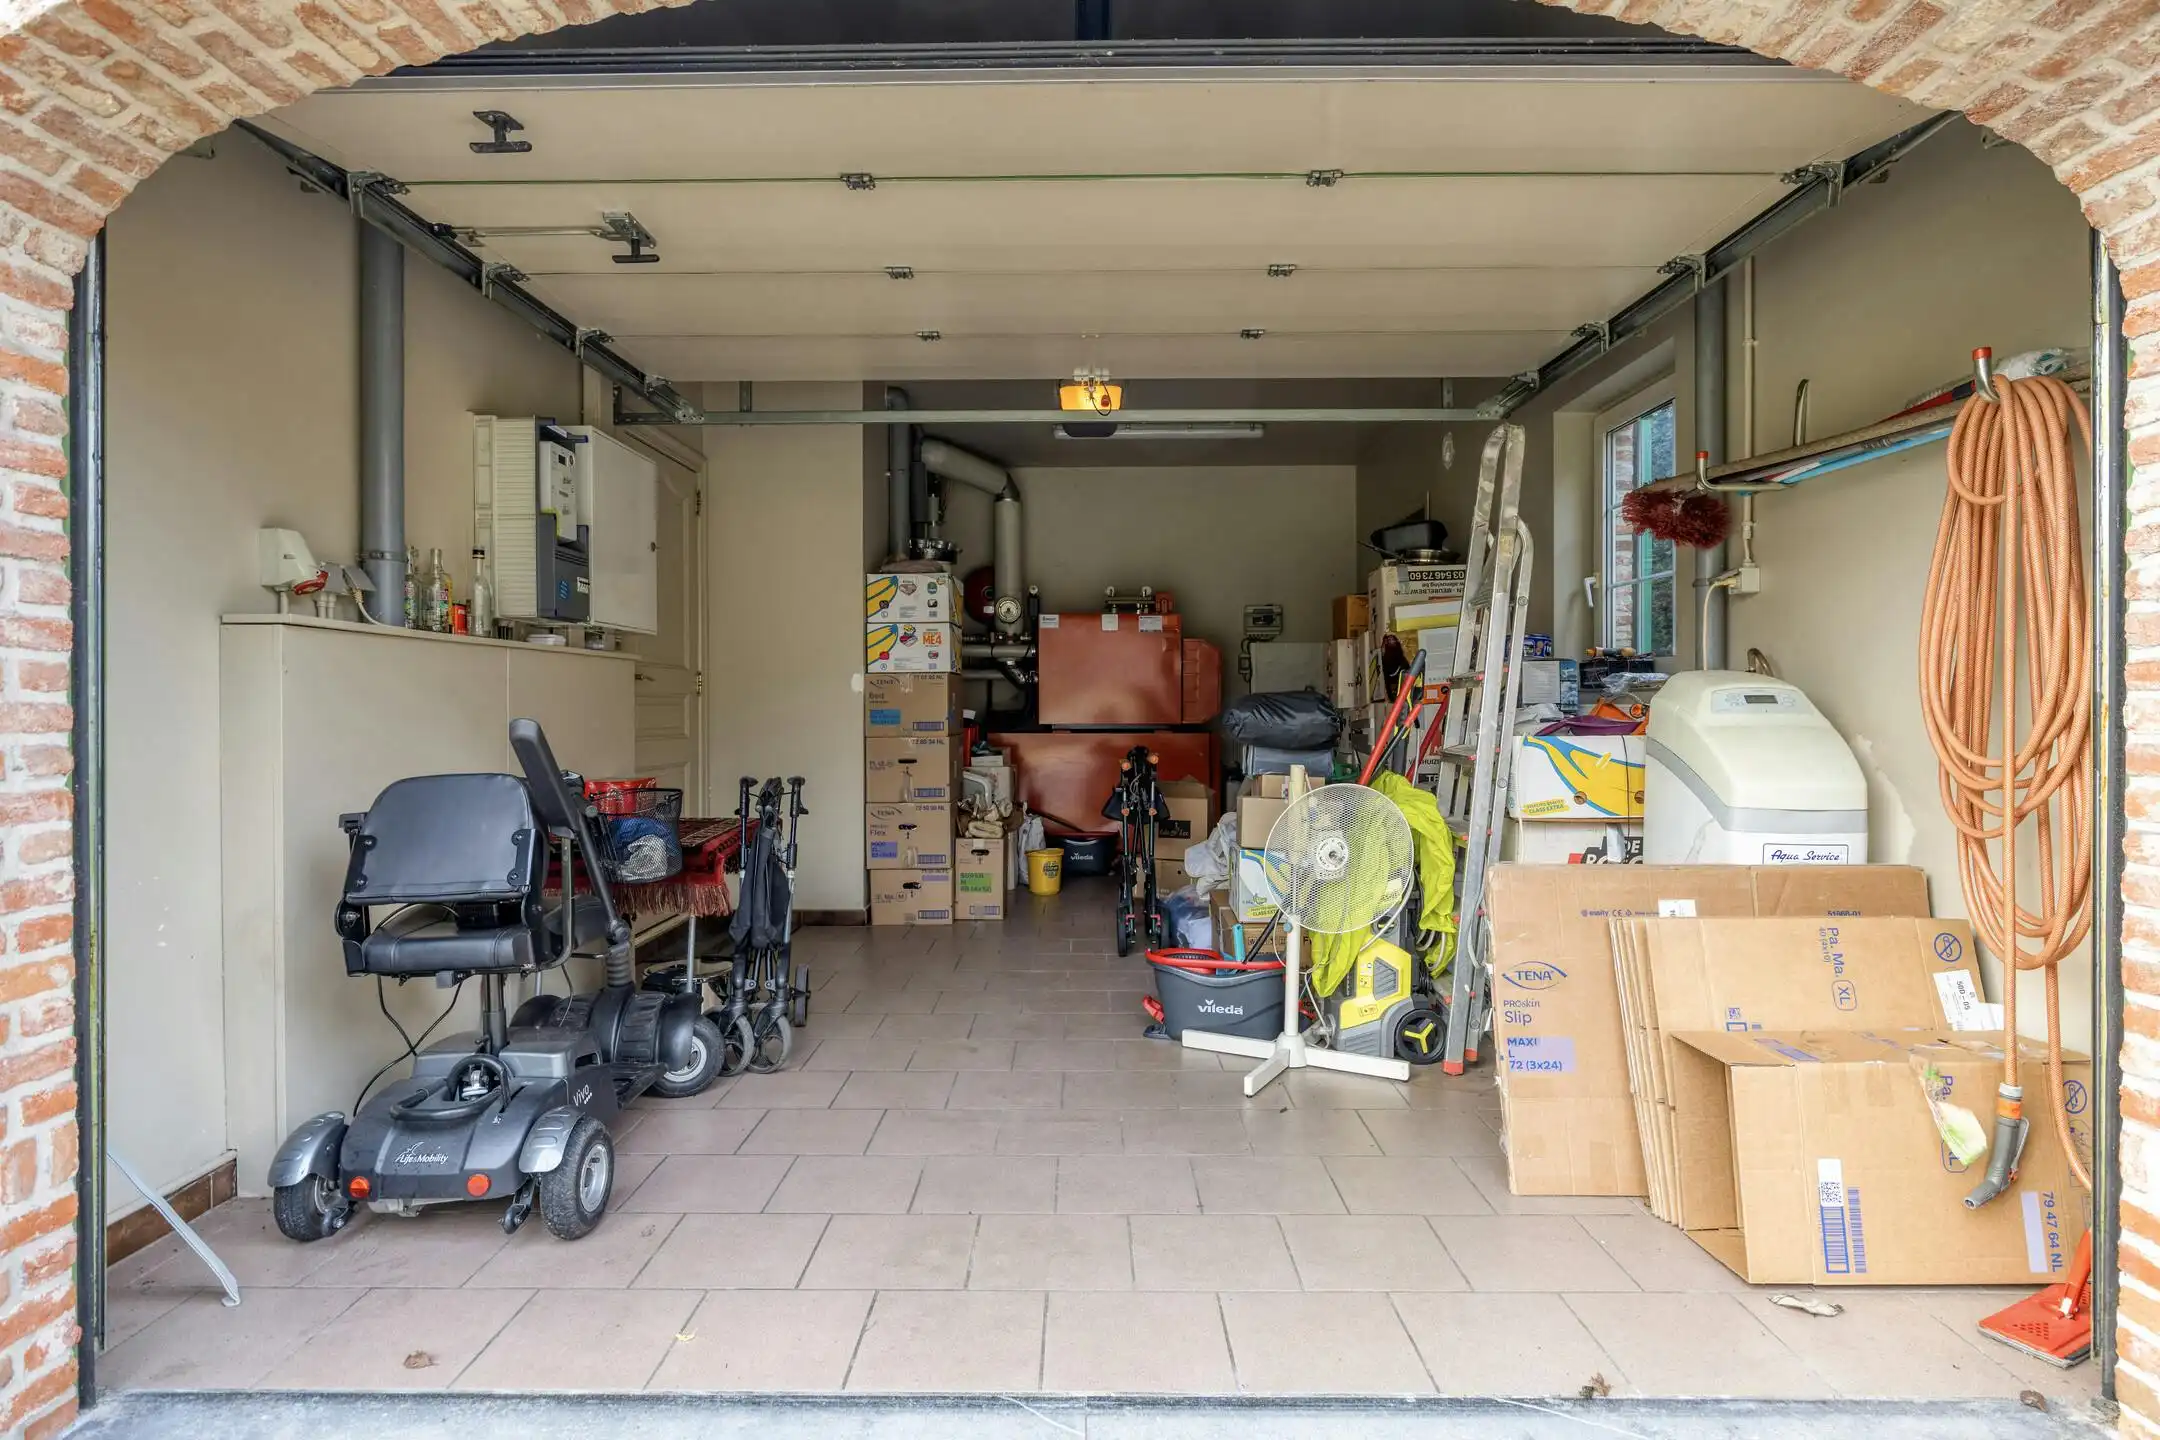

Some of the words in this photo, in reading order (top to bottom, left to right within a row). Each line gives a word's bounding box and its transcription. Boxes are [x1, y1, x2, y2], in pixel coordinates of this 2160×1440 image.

[1409, 572, 1421, 580] 60
[1422, 571, 1434, 580] 73
[1434, 571, 1452, 580] 546
[1453, 571, 1465, 579] 03
[1771, 849, 1799, 862] Aqua
[1803, 850, 1840, 861] Service
[1827, 927, 1840, 949] Pa.
[1832, 953, 1845, 978] Ma.
[1515, 970, 1553, 981] TENA
[1503, 998, 1541, 1008] PROskin
[1837, 986, 1851, 1005] XL
[1197, 998, 1244, 1016] vileda
[1504, 1010, 1532, 1026] Slip
[1507, 1037, 1538, 1047] MAXI
[1508, 1049, 1516, 1058] L
[1509, 1060, 1523, 1070] 72
[1525, 1060, 1563, 1071] (3x24)
[573, 1084, 590, 1107] Vivo
[1940, 1075, 1954, 1100] Pa.
[2042, 1191, 2055, 1208] 79
[2046, 1211, 2058, 1229] 47
[2048, 1231, 2061, 1249] 64
[2050, 1252, 2064, 1273] NL
